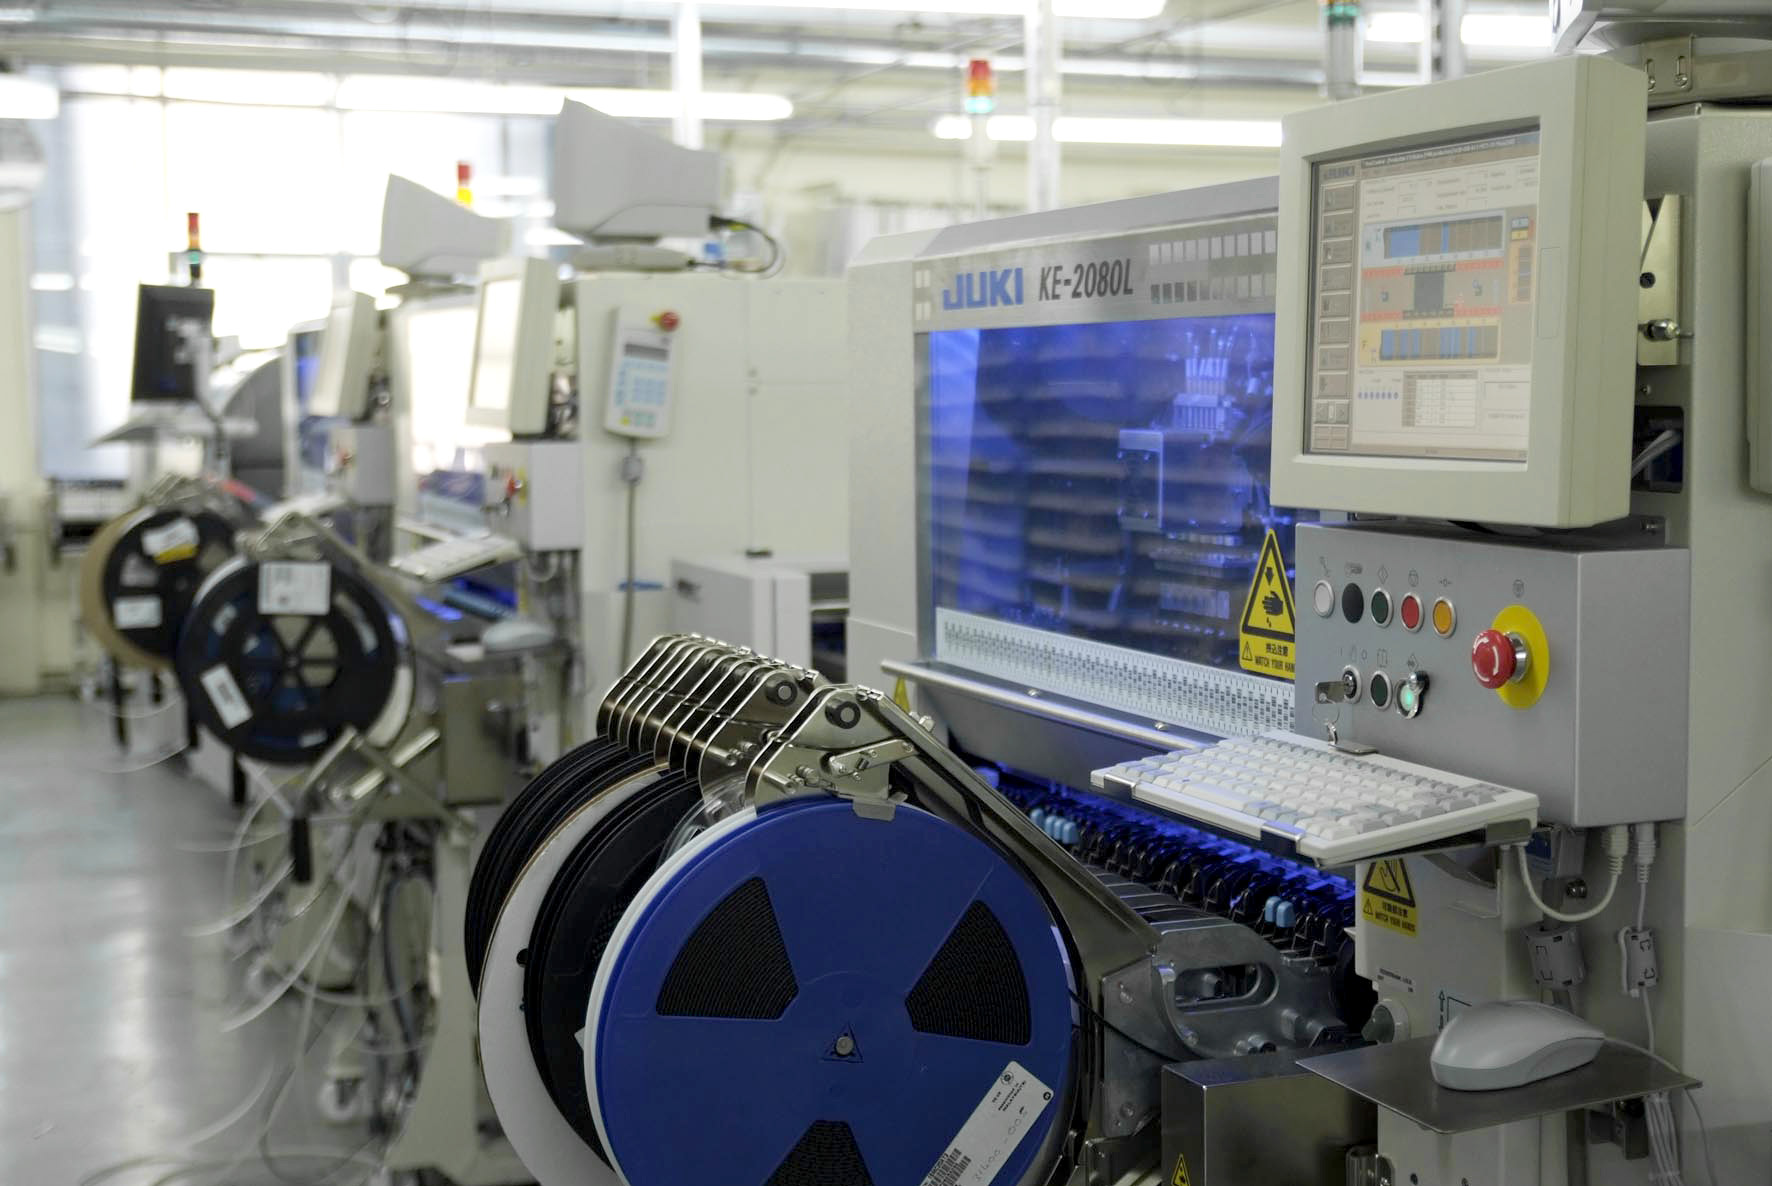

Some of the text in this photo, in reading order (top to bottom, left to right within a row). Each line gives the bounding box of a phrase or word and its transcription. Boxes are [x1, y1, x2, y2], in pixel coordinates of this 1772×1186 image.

[943, 258, 1134, 311] JUKI KE-2080L
[1255, 656, 1270, 667] WATCH
[1272, 659, 1284, 670] YOUR
